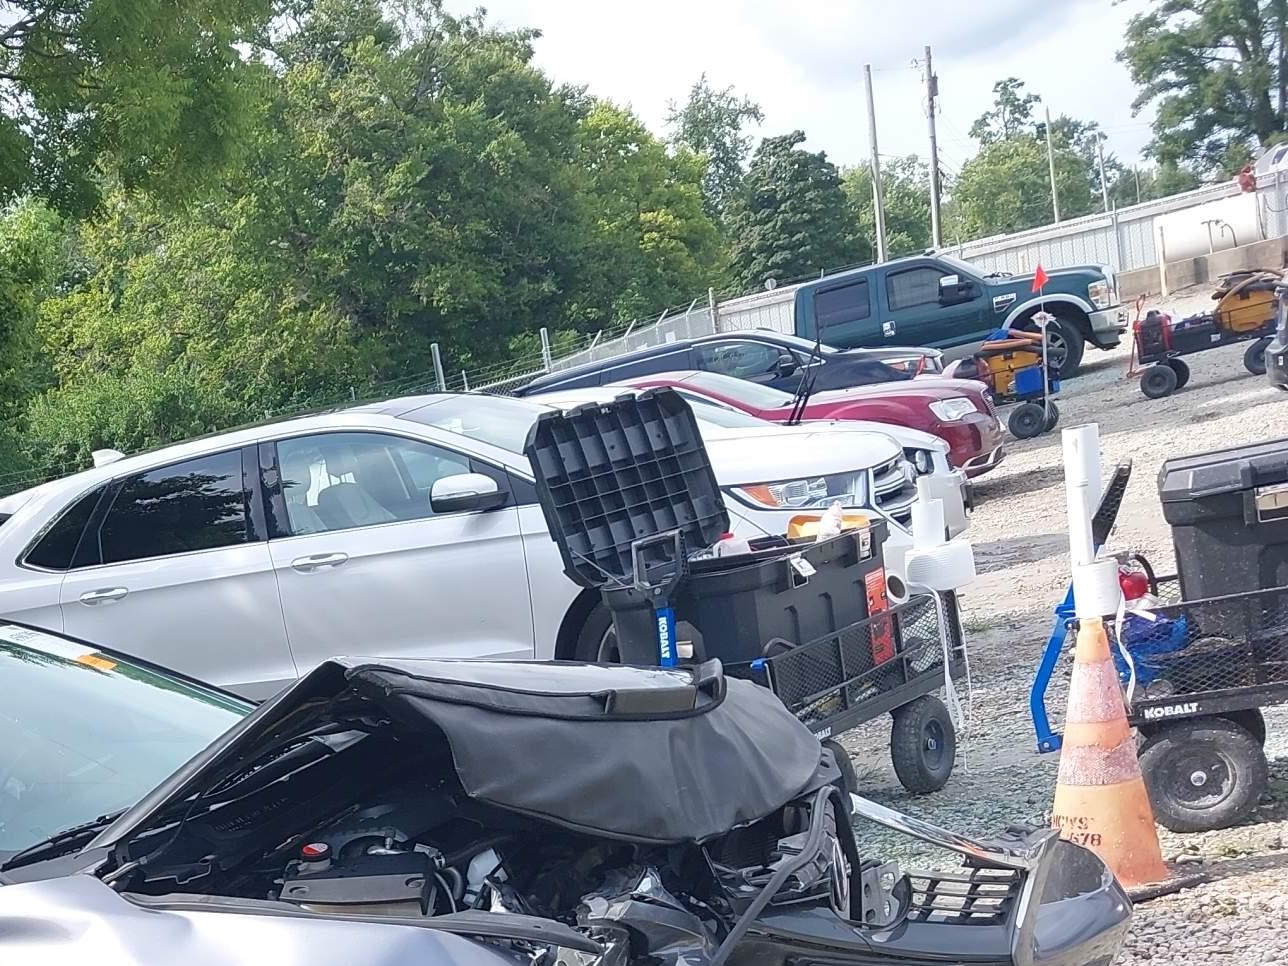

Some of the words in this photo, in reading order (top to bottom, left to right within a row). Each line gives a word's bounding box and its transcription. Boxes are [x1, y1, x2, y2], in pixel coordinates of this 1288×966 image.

[658, 616, 670, 658] KOBALT
[1144, 703, 1198, 719] KOBALT
[814, 727, 831, 740] BALT
